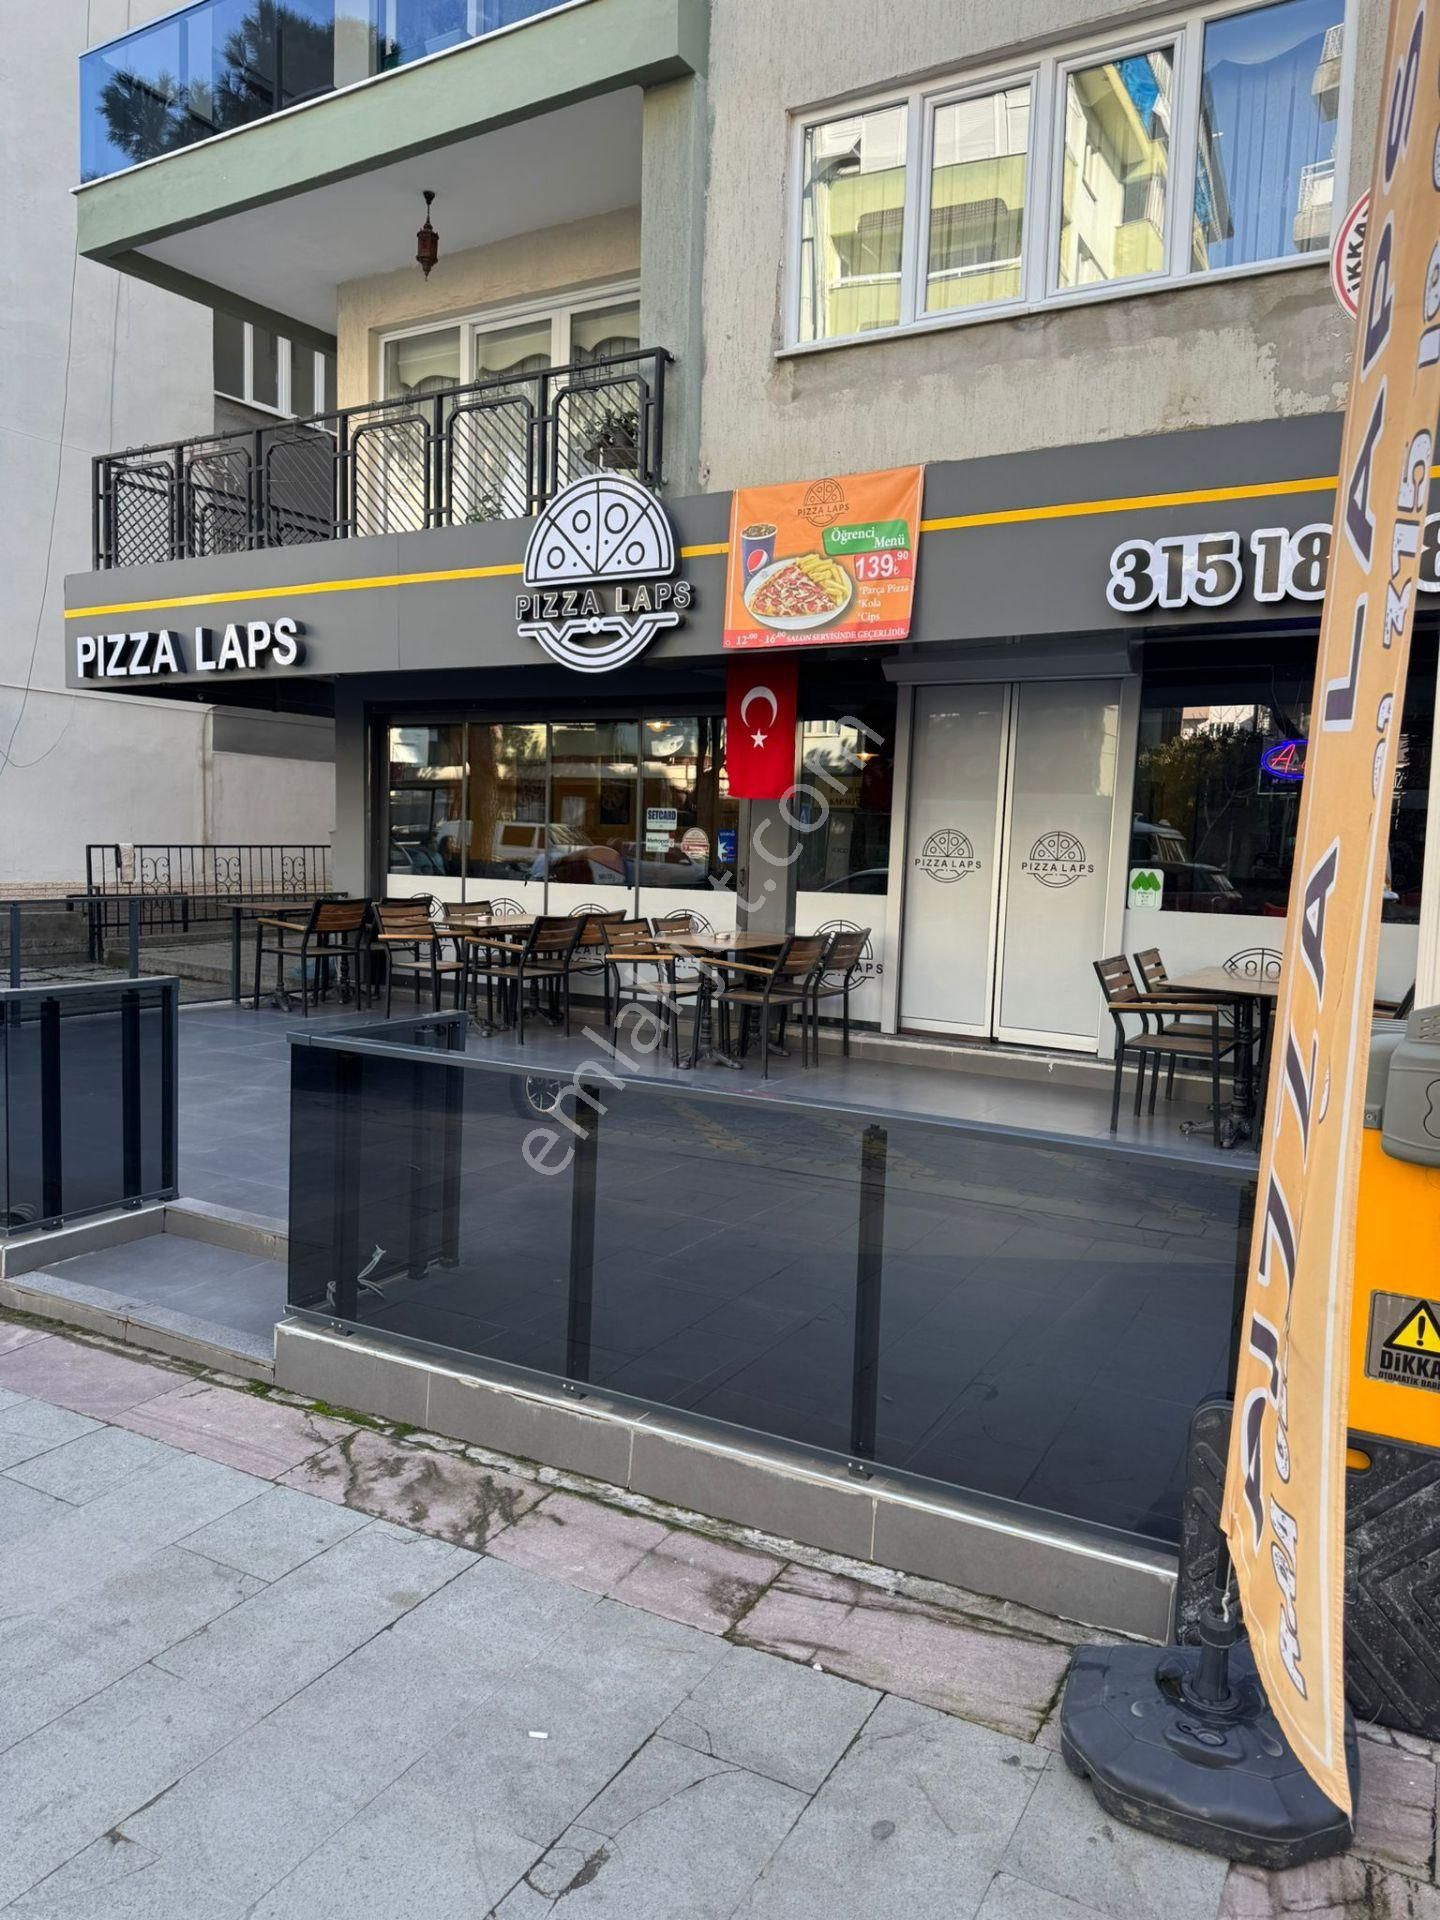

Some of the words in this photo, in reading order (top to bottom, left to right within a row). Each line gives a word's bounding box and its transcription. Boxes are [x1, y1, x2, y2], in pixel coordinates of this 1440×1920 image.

[1323, 0, 1427, 733] LAPS
[797, 504, 824, 517] PIZZA
[827, 502, 850, 514] LAPS
[831, 526, 875, 545] Öğrenci
[874, 534, 905, 550] Menü
[1105, 530, 1244, 613] 315
[1250, 522, 1335, 602] 18
[887, 583, 910, 594] Pizza
[515, 588, 602, 621] PIZZA
[615, 580, 692, 613] LAPS
[76, 629, 180, 679] PIZZA
[195, 616, 299, 671] LAPS
[647, 809, 677, 821] SETCARD
[914, 857, 948, 869] PIZZA
[951, 859, 982, 870] LAPS
[1021, 861, 1058, 873] PIZZA
[1061, 862, 1095, 874] LAPS
[854, 962, 884, 975] APS
